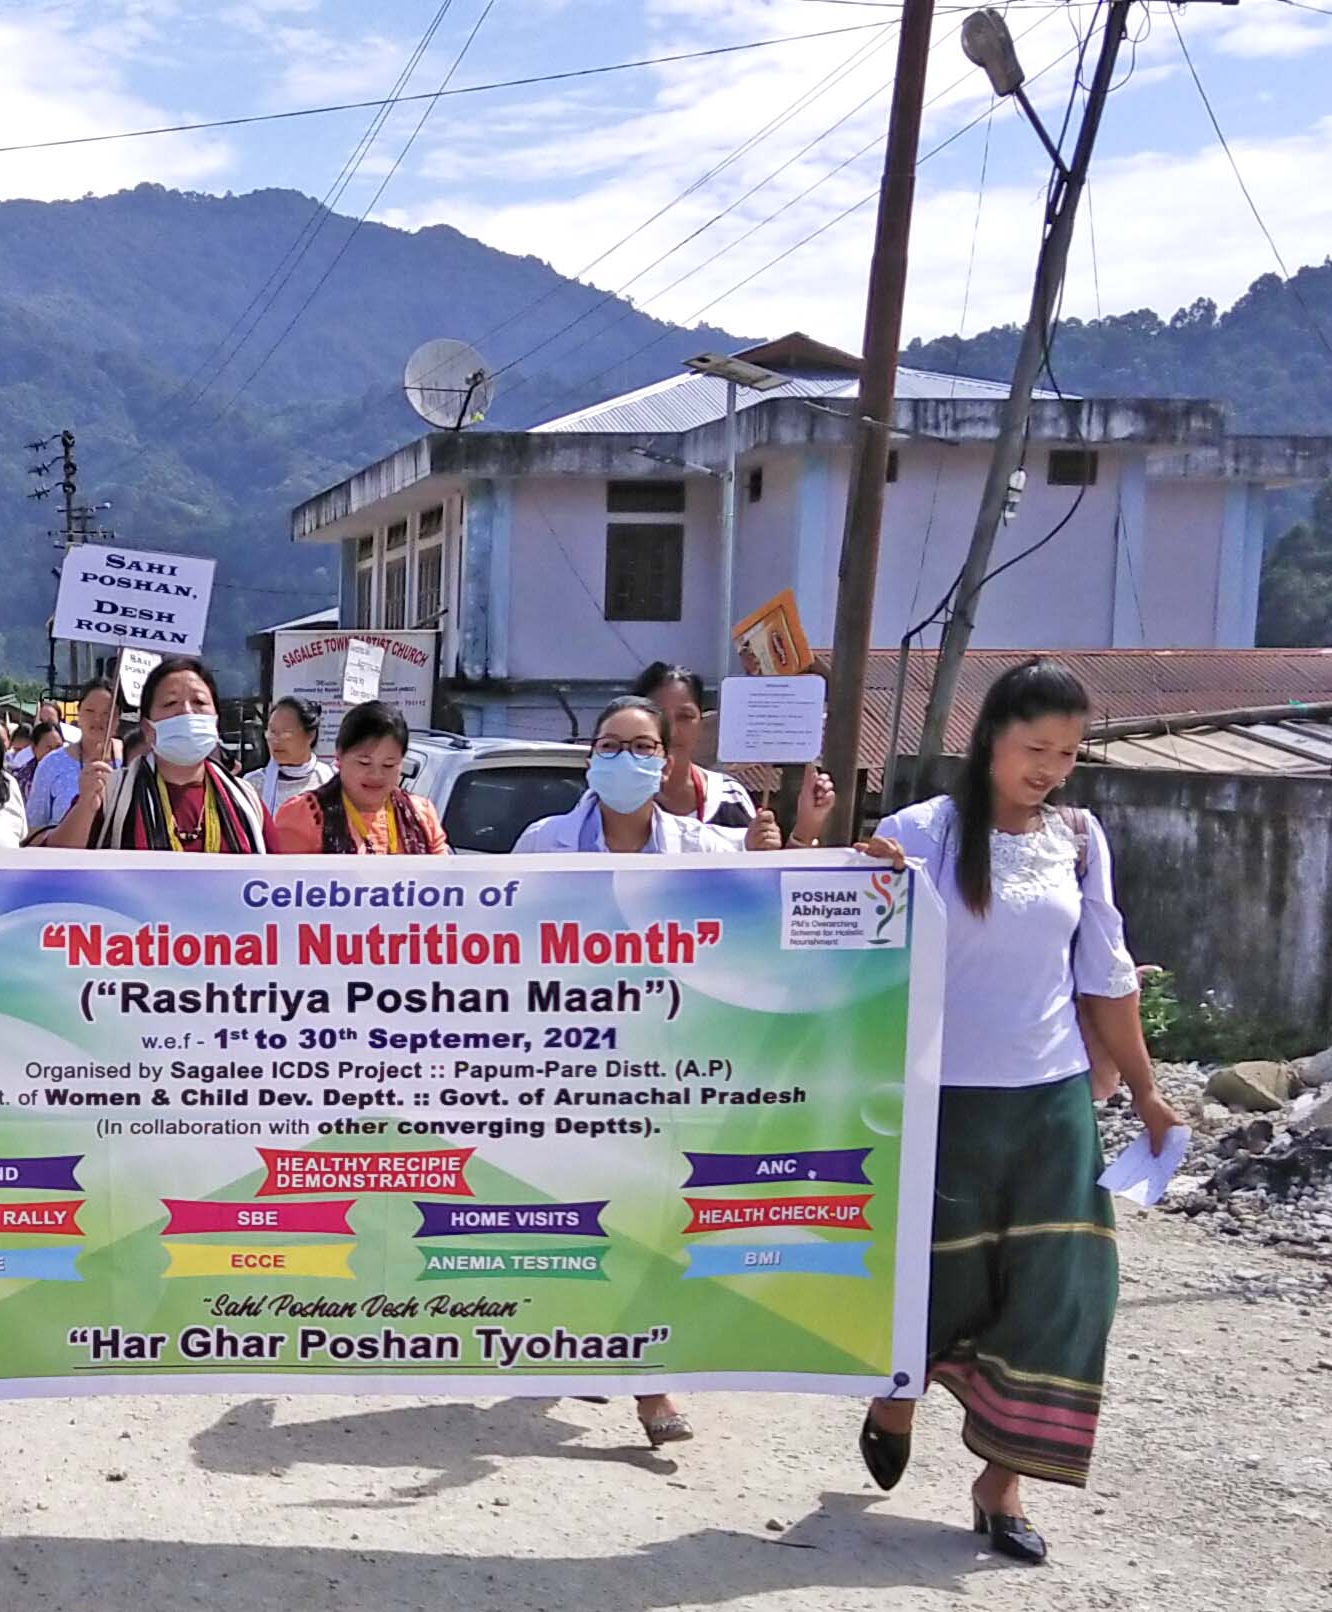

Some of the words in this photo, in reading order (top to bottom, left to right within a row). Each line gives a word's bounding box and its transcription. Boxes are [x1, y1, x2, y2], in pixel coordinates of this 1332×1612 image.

[105, 553, 179, 577] SAHI
[92, 599, 177, 624] DESH
[74, 618, 189, 644] ROSHAN
[282, 641, 323, 668] SAGALEE
[392, 641, 429, 668] CHURCH
[242, 880, 464, 908] Celebration
[479, 880, 519, 908] of
[791, 891, 858, 903] POSHAN
[791, 904, 861, 919] Abhiyaan
[43, 923, 277, 967] “National
[299, 922, 520, 966] Nutrition
[540, 921, 721, 965] Month”
[81, 981, 330, 1022] (“Rashtriya
[347, 981, 509, 1013] Poshan
[528, 980, 681, 1020] Maah”)
[141, 1032, 191, 1050] w.e.f
[214, 1028, 248, 1050] 1st
[254, 1029, 287, 1050] to
[298, 1028, 357, 1050] 30th
[368, 1028, 532, 1054] Septemer,
[544, 1027, 617, 1050] 2021
[25, 1061, 132, 1083] Organised
[138, 1061, 164, 1083] by
[170, 1061, 264, 1084] Sagalee
[271, 1061, 329, 1080] ICDS
[338, 1061, 422, 1084] Project
[454, 1060, 597, 1083] Papum-Pare
[605, 1060, 667, 1078] Distt.
[675, 1058, 733, 1082] (A.P)
[17, 1088, 39, 1106] of
[44, 1088, 142, 1107] Women
[151, 1088, 172, 1107] &
[180, 1088, 249, 1107] Child
[258, 1088, 314, 1107] Dev.
[323, 1088, 405, 1111] Deptt.
[438, 1088, 510, 1107] Govt.
[517, 1087, 546, 1106] of
[553, 1086, 691, 1106] Arunachal
[700, 1086, 807, 1105] Pradesh
[96, 1117, 123, 1139] (In
[129, 1118, 262, 1135] collaboration
[268, 1118, 310, 1135] with
[317, 1117, 389, 1136] other
[396, 1117, 546, 1141] converging
[554, 1116, 661, 1139] Deptts).
[276, 1157, 372, 1172] HEALTHY
[378, 1157, 461, 1172] RECIPIE
[755, 1159, 798, 1176] ANC
[276, 1173, 456, 1188] DEMONSTRATION
[3, 1210, 67, 1226] RALLY
[237, 1210, 279, 1226] SBE
[450, 1211, 510, 1227] HOME
[515, 1211, 580, 1227] VISITS
[698, 1206, 766, 1225] HEALTH
[769, 1205, 861, 1221] CHECK-UP
[230, 1253, 286, 1269] ECCE
[426, 1255, 506, 1270] ANEMIA
[511, 1255, 597, 1270] TESTING
[744, 1250, 781, 1265] BMI
[267, 1293, 358, 1318] Poshan
[360, 1293, 420, 1318] Desh
[69, 1329, 166, 1360] “Har
[180, 1329, 285, 1360] Ghar
[300, 1329, 460, 1360] Poshan
[476, 1327, 669, 1367] Tyohaar”
